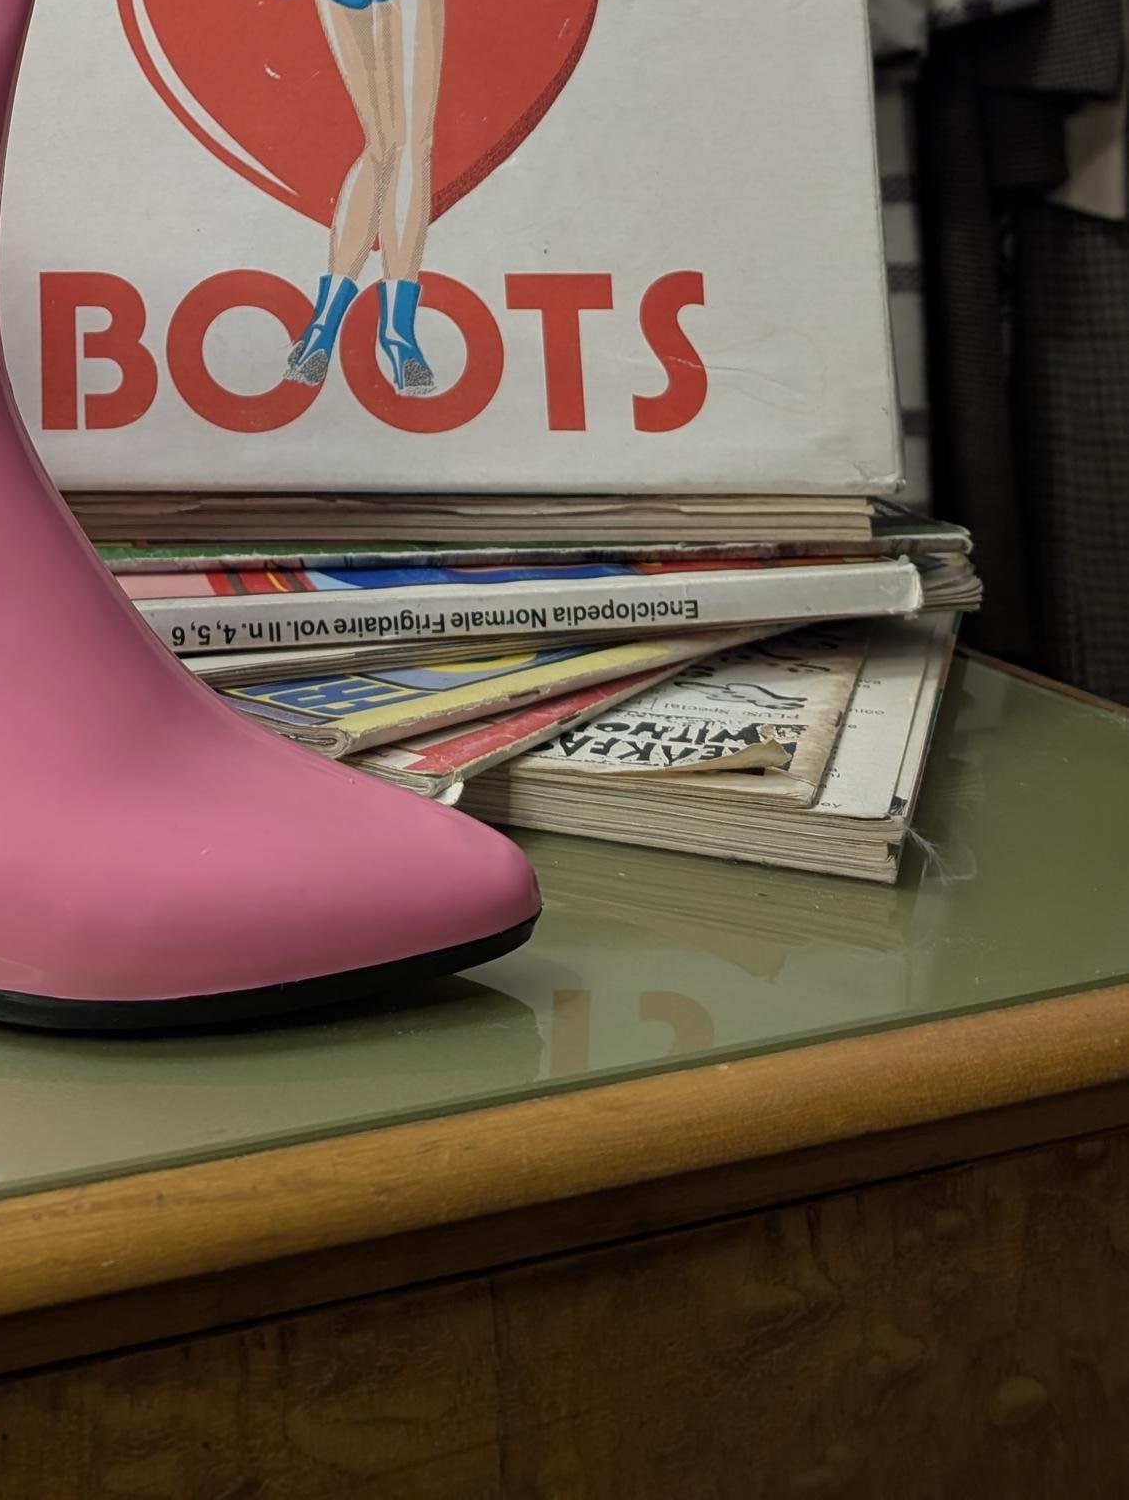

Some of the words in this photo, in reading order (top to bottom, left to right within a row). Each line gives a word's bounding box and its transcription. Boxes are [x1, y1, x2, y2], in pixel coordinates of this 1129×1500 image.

[39, 268, 709, 433] BOOTS
[333, 609, 446, 634] Frigidaire
[451, 607, 547, 630] Normale
[552, 599, 700, 627] Enciclopedia
[171, 624, 186, 647] 6
[286, 617, 329, 641] vol.
